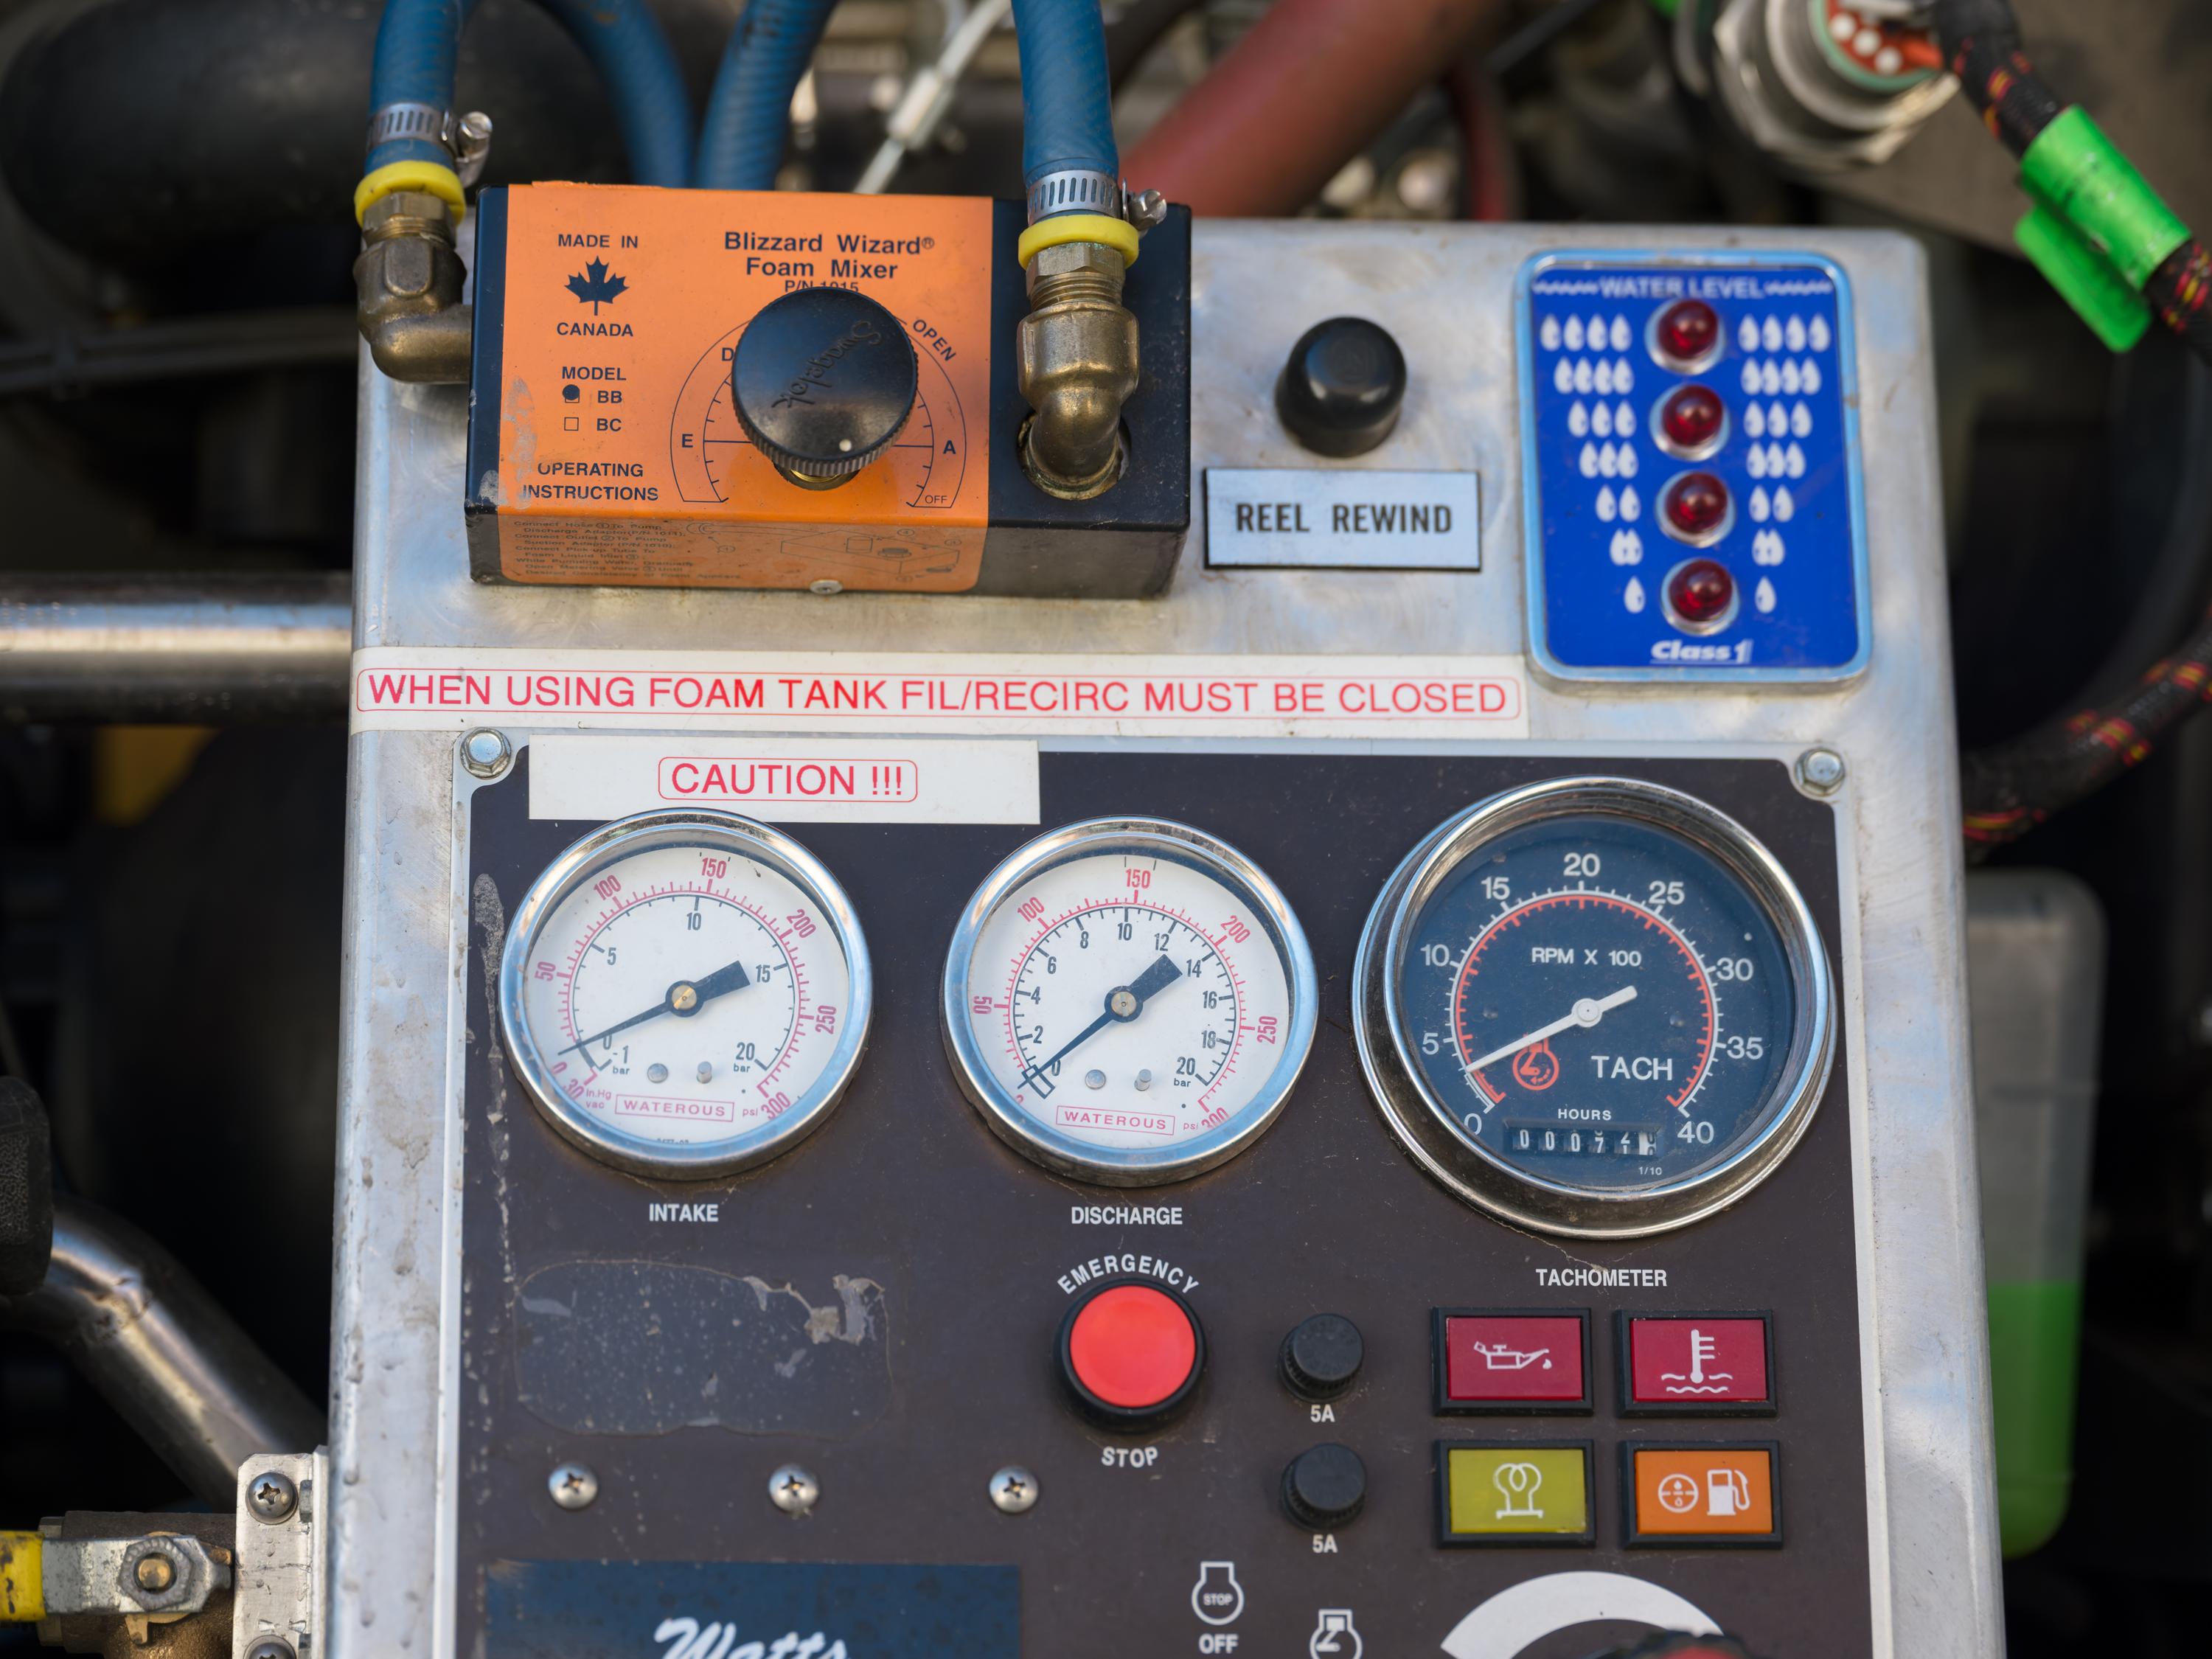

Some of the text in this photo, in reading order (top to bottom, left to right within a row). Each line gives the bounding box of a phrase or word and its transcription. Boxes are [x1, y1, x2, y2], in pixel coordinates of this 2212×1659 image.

[558, 234, 639, 249] MADE IN
[725, 231, 823, 252] Blizzard
[746, 257, 898, 279] Foam Mixer
[785, 280, 813, 293] P/N
[1598, 276, 1765, 300] WATER LEVEL
[557, 322, 634, 338] CANADA
[912, 319, 956, 362] OPEN
[561, 366, 627, 381] MODEL
[597, 391, 622, 404] BB
[597, 417, 622, 432] BC
[681, 434, 694, 448] E
[942, 440, 956, 455] A
[538, 462, 644, 477] OPERATING
[523, 484, 659, 501] INSTRUCTIONS
[925, 494, 947, 504] OFF
[1236, 503, 1453, 535] REEL REWIND
[369, 674, 1506, 714] WHEN USING FOAM TANK FIL/RECIRC MUST BE CLOSED
[671, 762, 902, 796] CAUTION !!!
[701, 858, 727, 880] 150
[1562, 852, 1601, 877] 20
[593, 874, 622, 900] 100
[1125, 869, 1151, 889] 150
[1481, 877, 1511, 900] 15
[1647, 880, 1686, 905] 25
[1017, 897, 1045, 923] 100
[686, 912, 702, 931] 10
[786, 908, 816, 939] 200
[1220, 914, 1251, 944] 200
[1079, 931, 1089, 950] 8
[1117, 922, 1133, 941] 10
[1154, 933, 1170, 951] 12
[607, 947, 617, 965] 5
[1420, 944, 1450, 967] 10
[1531, 947, 1642, 967] RPM X 100
[534, 961, 557, 982] 50
[755, 964, 771, 984] 15
[1047, 956, 1057, 975] 6
[1186, 959, 1203, 978] 14
[1717, 957, 1754, 981] 30
[973, 995, 992, 1015] 50
[1030, 987, 1041, 1005] 4
[1203, 990, 1217, 1009] 16
[815, 1005, 838, 1034] 250
[1033, 1025, 1043, 1044] 2
[1201, 1030, 1217, 1049] 18
[1256, 1015, 1279, 1045] 250
[735, 1041, 756, 1061] 20
[1422, 1032, 1440, 1056] 5
[1727, 1035, 1764, 1060] 35
[613, 1065, 630, 1075] bar
[733, 1062, 751, 1073] bar
[1051, 1059, 1061, 1077] 0
[1175, 1056, 1196, 1076] 20
[1590, 1054, 1673, 1081] TACH
[1173, 1077, 1192, 1088] bar
[585, 1101, 605, 1109] vac
[624, 1099, 726, 1117] WATEROUS
[742, 1107, 758, 1117] psi
[761, 1091, 791, 1121] 300
[1557, 1108, 1612, 1121] HOURS
[1063, 1110, 1167, 1130] WATEROUS
[1183, 1122, 1198, 1130] psi
[1464, 1112, 1483, 1136] 0
[1677, 1121, 1715, 1144] 40
[1638, 1166, 1663, 1176] 1/10
[649, 1203, 719, 1222] INTAKE
[1071, 1206, 1183, 1225] DISCHARGE
[1057, 1253, 1200, 1295] EMERGENCY
[1535, 1268, 1668, 1287] TACHOMETER
[1310, 1404, 1335, 1423] 5A
[1101, 1446, 1159, 1469] STOP
[1312, 1534, 1338, 1553] 5A
[1203, 1593, 1234, 1607] STOP
[1199, 1632, 1239, 1655] OFF
